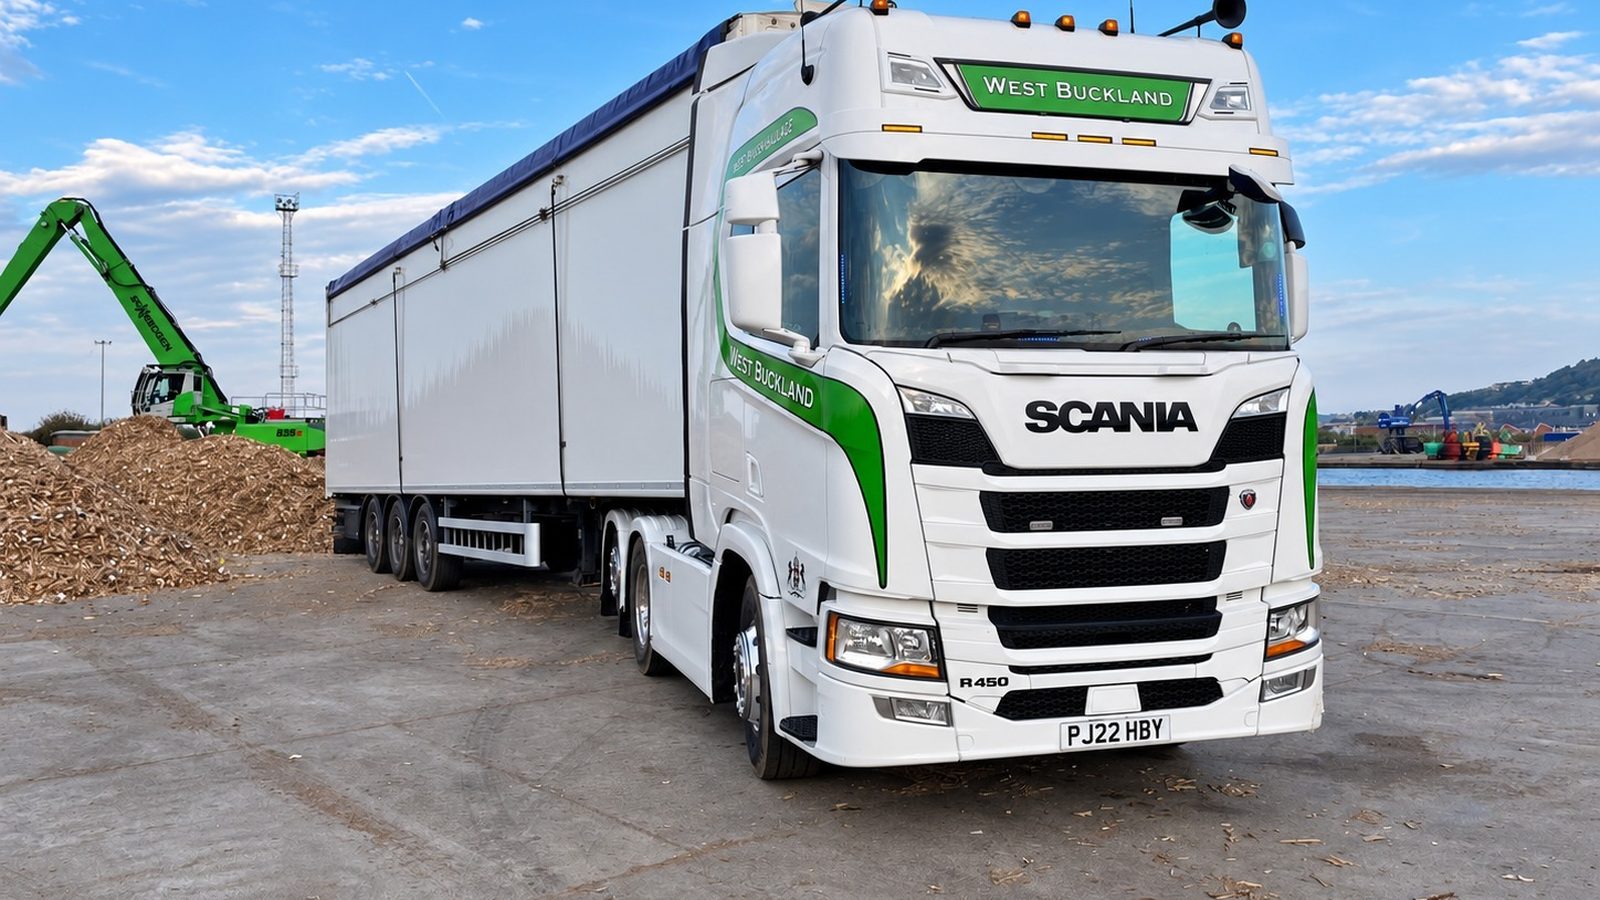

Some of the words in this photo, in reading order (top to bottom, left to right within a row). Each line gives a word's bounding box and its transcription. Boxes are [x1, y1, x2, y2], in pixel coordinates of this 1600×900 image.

[983, 76, 1048, 97] WEST
[1056, 81, 1173, 106] BUCKLAND
[730, 345, 753, 376] WEST
[755, 360, 814, 408] BUCKLAND
[1025, 400, 1199, 433] SCANIA
[960, 677, 1009, 688] R450
[1067, 721, 1120, 746] PJ22
[1126, 718, 1163, 741] HBY
